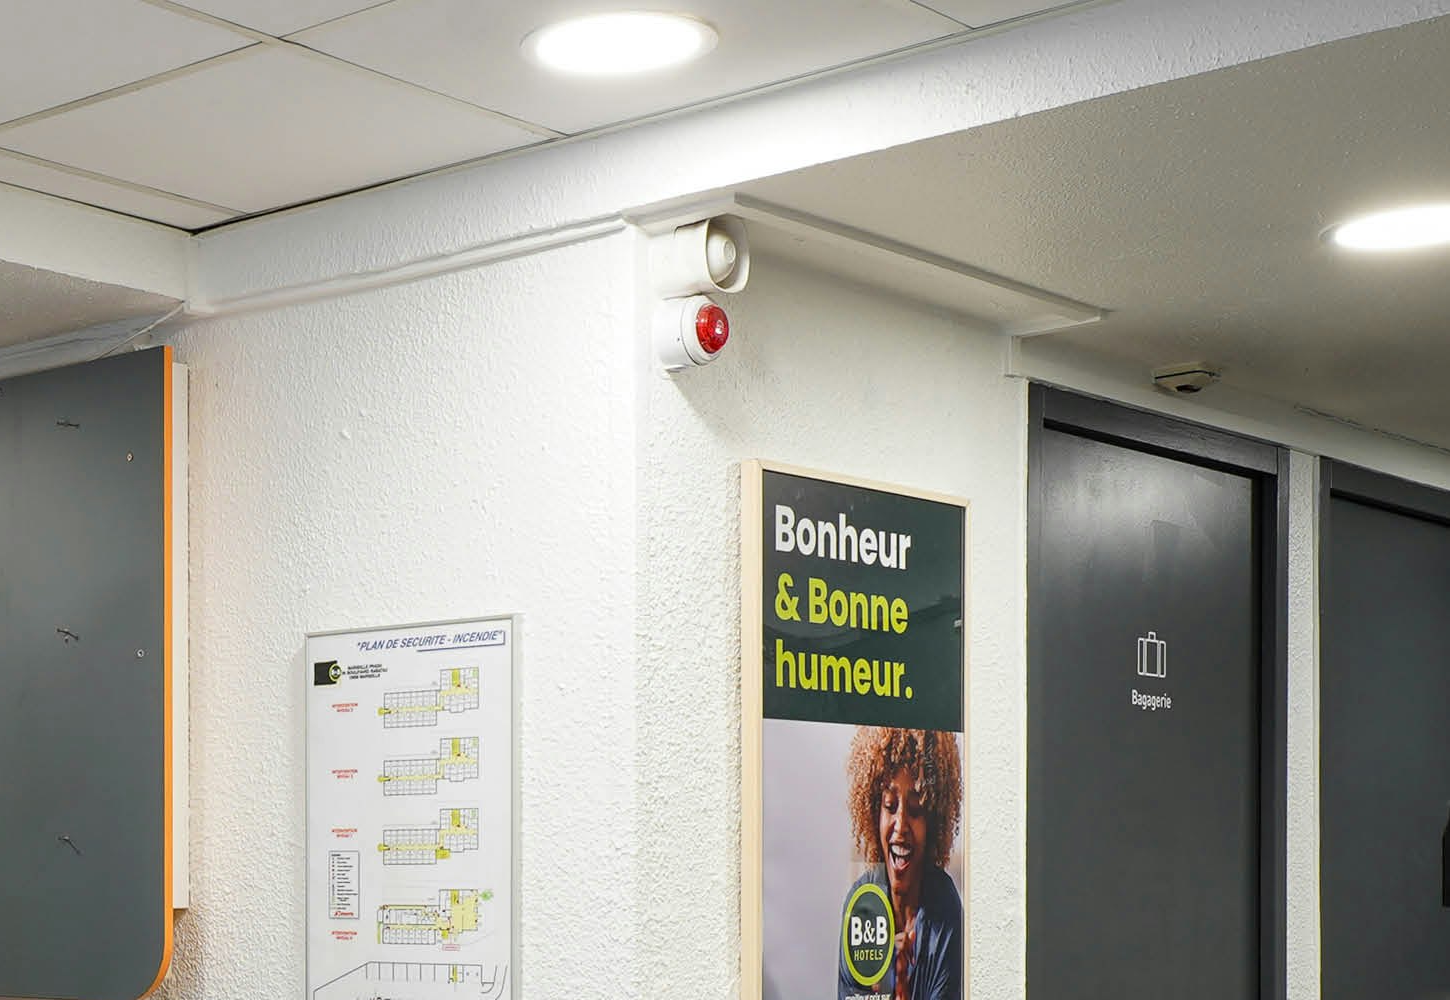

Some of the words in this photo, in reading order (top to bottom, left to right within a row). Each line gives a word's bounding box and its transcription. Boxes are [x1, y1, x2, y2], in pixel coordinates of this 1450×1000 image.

[775, 504, 912, 570] Bonheur
[774, 572, 802, 623] &
[808, 577, 909, 635] Bonne
[385, 639, 400, 649] DE
[775, 638, 914, 700] humeur.
[1131, 688, 1172, 711] Bagagerie
[850, 915, 888, 946] B&B
[853, 949, 884, 961] HOTELS
